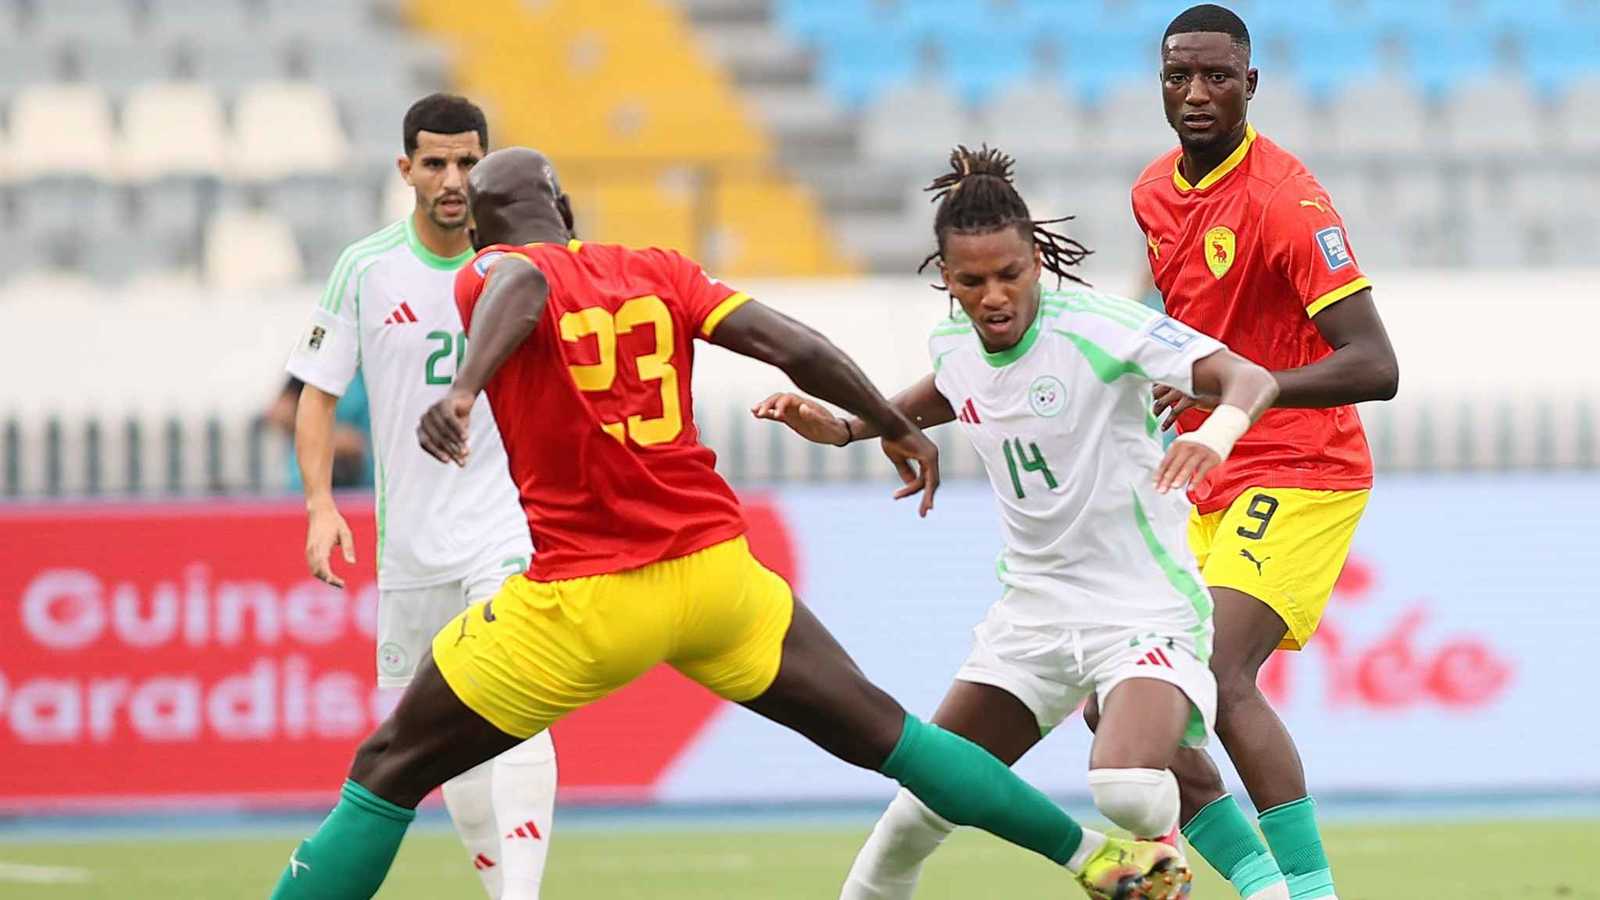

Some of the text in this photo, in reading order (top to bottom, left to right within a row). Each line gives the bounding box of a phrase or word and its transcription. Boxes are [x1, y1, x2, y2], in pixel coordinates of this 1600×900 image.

[559, 294, 683, 447] 23
[1003, 436, 1058, 499] 14
[1236, 493, 1279, 540] 9
[0, 655, 402, 743] aradis
